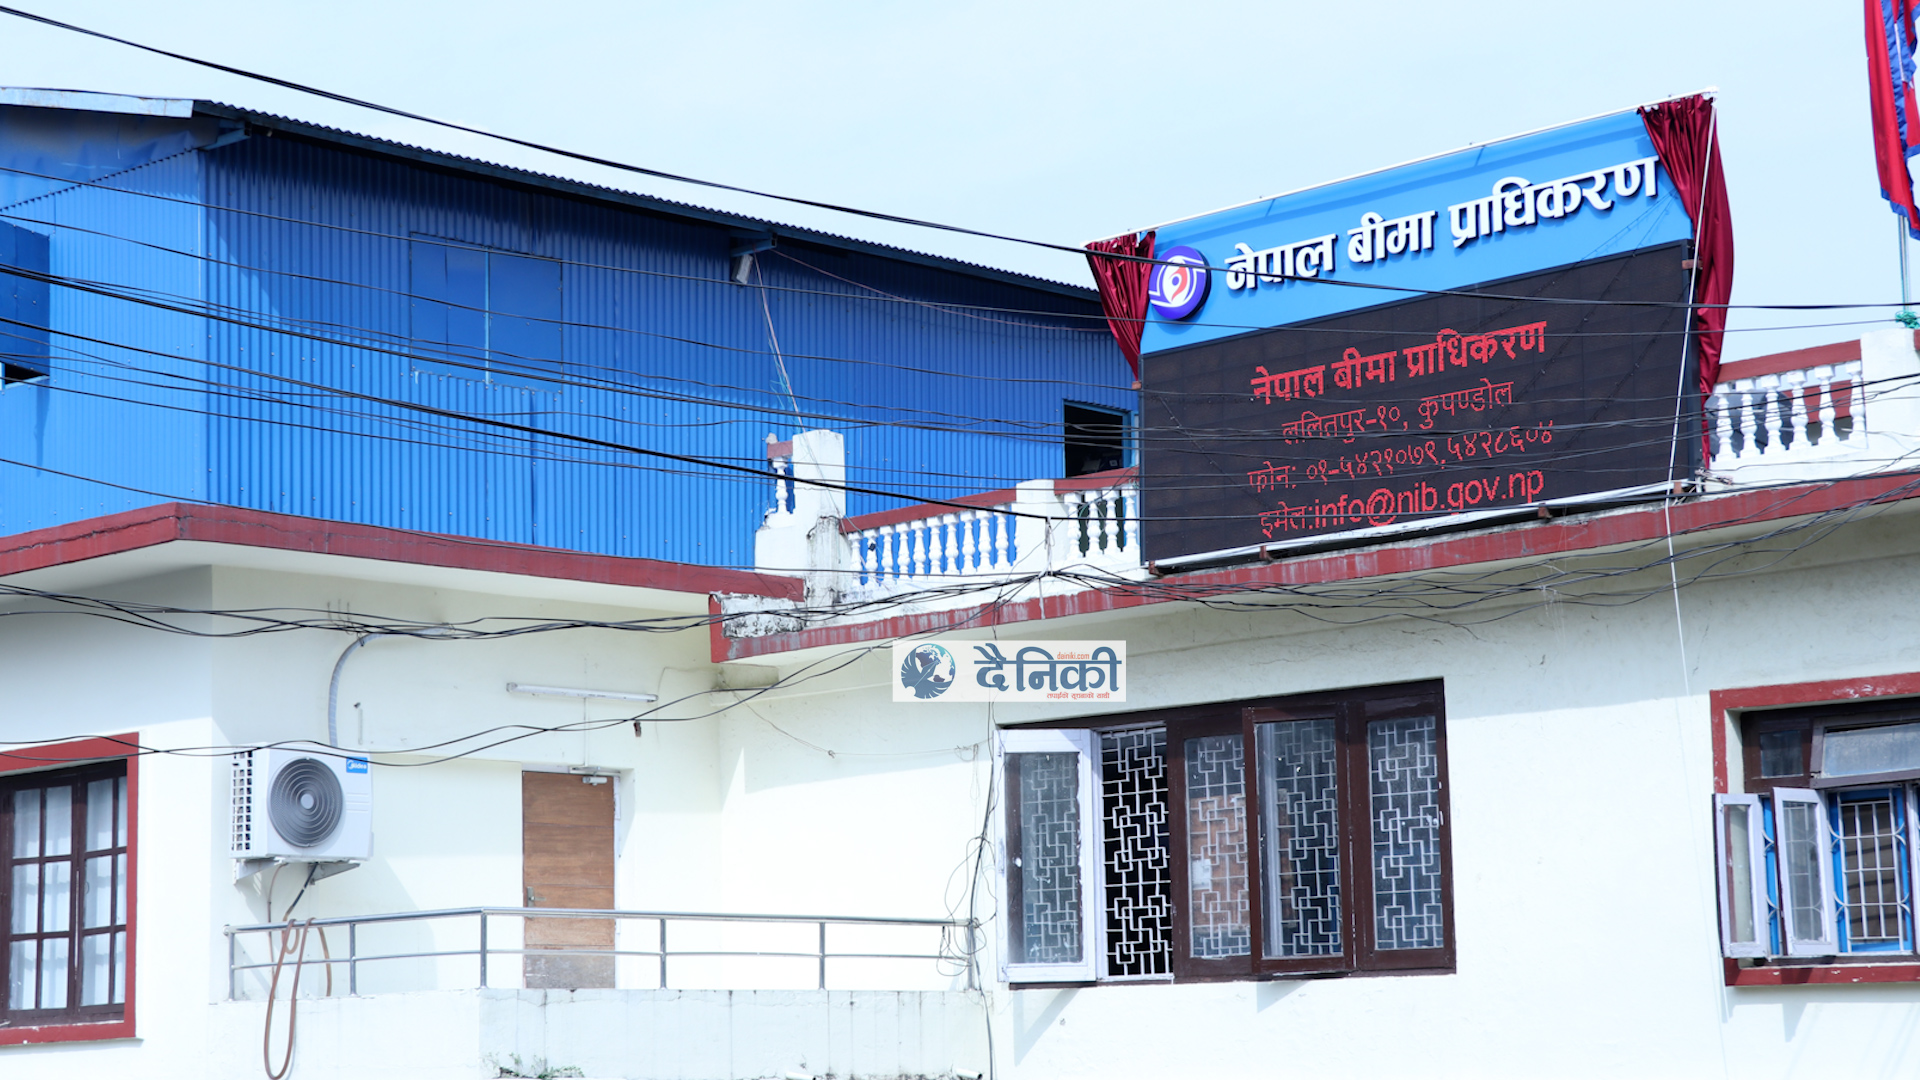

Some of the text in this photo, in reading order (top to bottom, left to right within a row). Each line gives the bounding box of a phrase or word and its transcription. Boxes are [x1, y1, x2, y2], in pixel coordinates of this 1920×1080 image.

[1224, 155, 1659, 291] नेपाल बीमा प्राधिकरण
[1250, 320, 1548, 405] नेपाल बीमा प्राधिकरण
[1418, 377, 1515, 430] कुपण्डोल
[1246, 460, 1297, 493] फोन:
